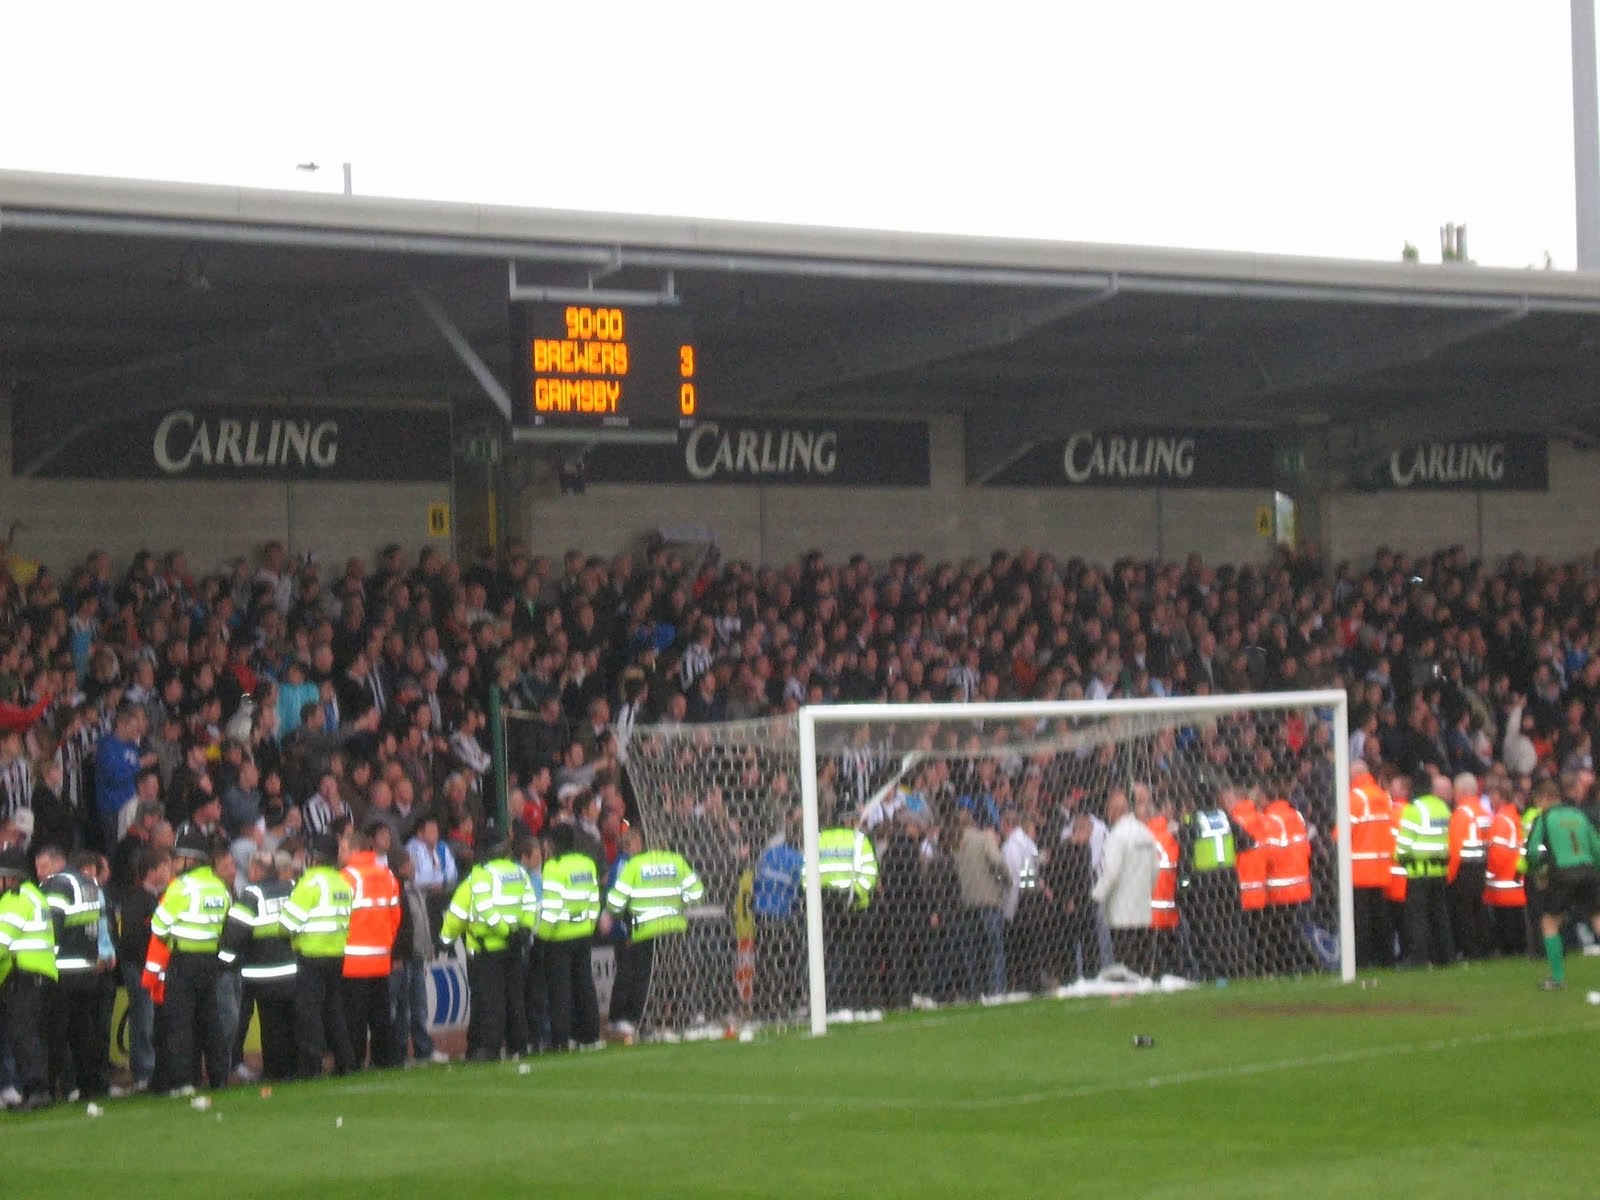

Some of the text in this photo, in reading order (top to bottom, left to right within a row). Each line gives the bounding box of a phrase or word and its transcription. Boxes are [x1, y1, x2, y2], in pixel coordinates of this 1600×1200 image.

[565, 306, 624, 341] 90:00
[533, 338, 695, 377] BREWERS 3
[534, 378, 696, 415] GRIMSBY 0
[153, 410, 338, 472] CARLING
[685, 422, 838, 480] CARLING
[1064, 431, 1195, 483] CARLING
[1389, 442, 1505, 487] CARLING
[642, 864, 676, 876] POLICE
